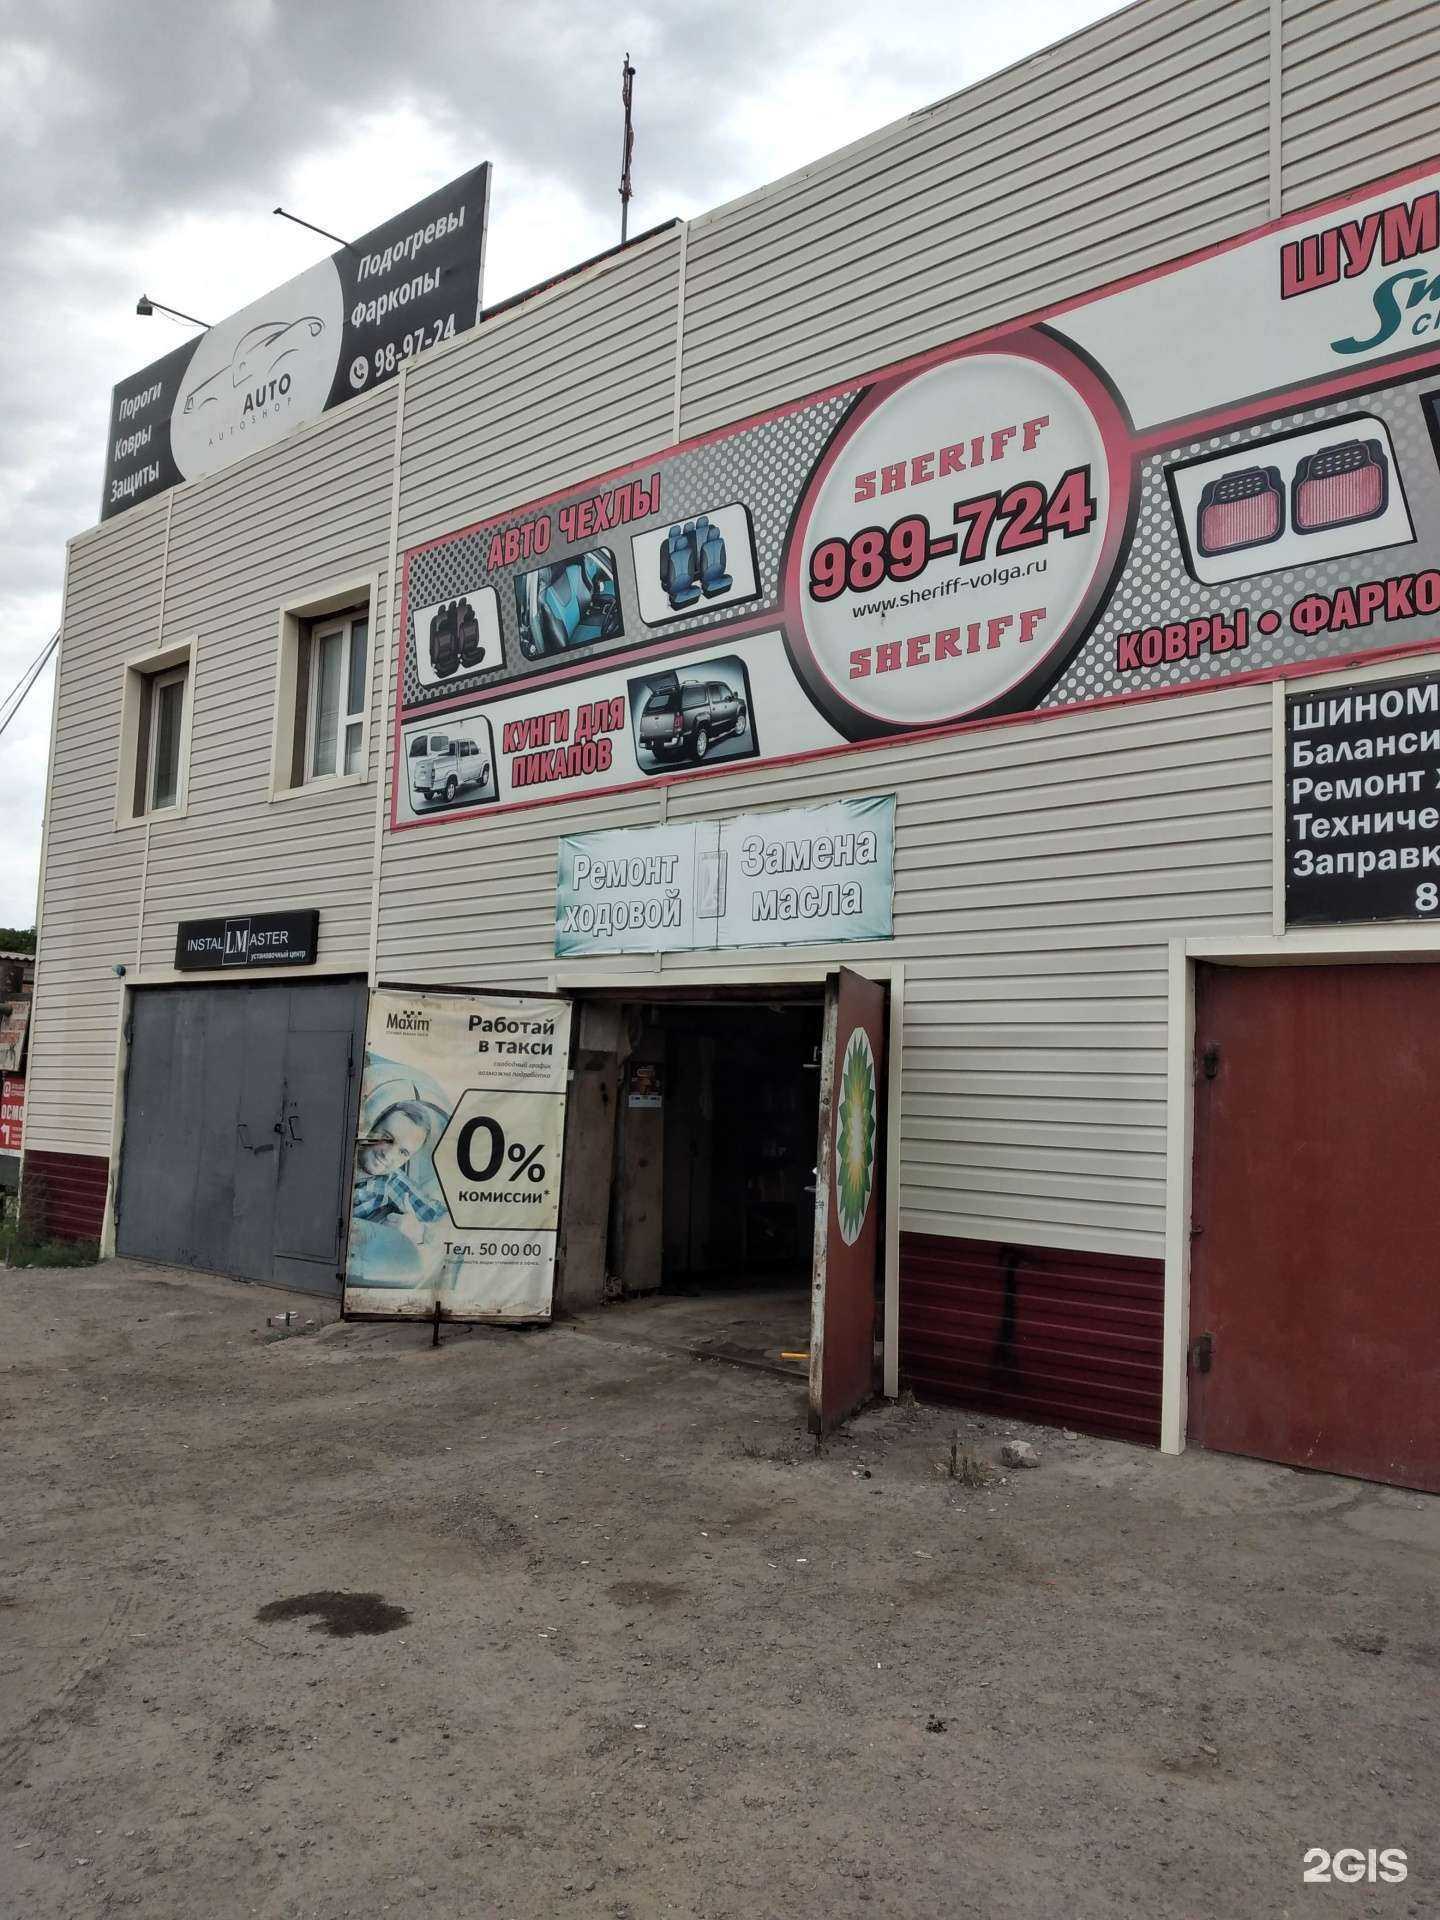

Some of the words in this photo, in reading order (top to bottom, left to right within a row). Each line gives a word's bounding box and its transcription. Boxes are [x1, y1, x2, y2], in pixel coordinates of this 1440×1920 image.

[357, 205, 465, 282] Подогревы
[351, 267, 440, 327] Фаркопы
[119, 381, 162, 422] Пороги
[243, 373, 291, 415] AUTO
[114, 425, 152, 462] Ковры
[854, 415, 1050, 503] SHERIFF
[110, 461, 160, 503] Защиты
[487, 515, 551, 572] АВТО
[559, 472, 661, 544] ЧЕХЛЫ
[809, 464, 1097, 602] 989-724
[852, 559, 1048, 617] www.sheriff-volga.ru
[1116, 608, 1249, 672] КОВРЫ
[1290, 569, 1440, 636] ФАРКО
[849, 607, 1047, 680] SHERIFF
[502, 709, 570, 754] КУНГИ
[576, 696, 625, 743] ДЛЯ
[511, 738, 613, 788] ПИКАПОВ
[1293, 770, 1426, 804] Ремонт
[1293, 806, 1440, 841] Техниче
[572, 854, 678, 891] Ремонт
[741, 830, 877, 877] Замена
[562, 889, 682, 937] ходовой
[752, 881, 863, 921] масла
[1415, 882, 1439, 911] 8
[386, 1012, 430, 1031] Maxim
[468, 1015, 555, 1036] Работай
[479, 1040, 489, 1053] в
[495, 1041, 553, 1056] такси
[457, 1116, 546, 1182] 0%
[443, 1242, 474, 1255] Тел.
[480, 1243, 497, 1255] 50
